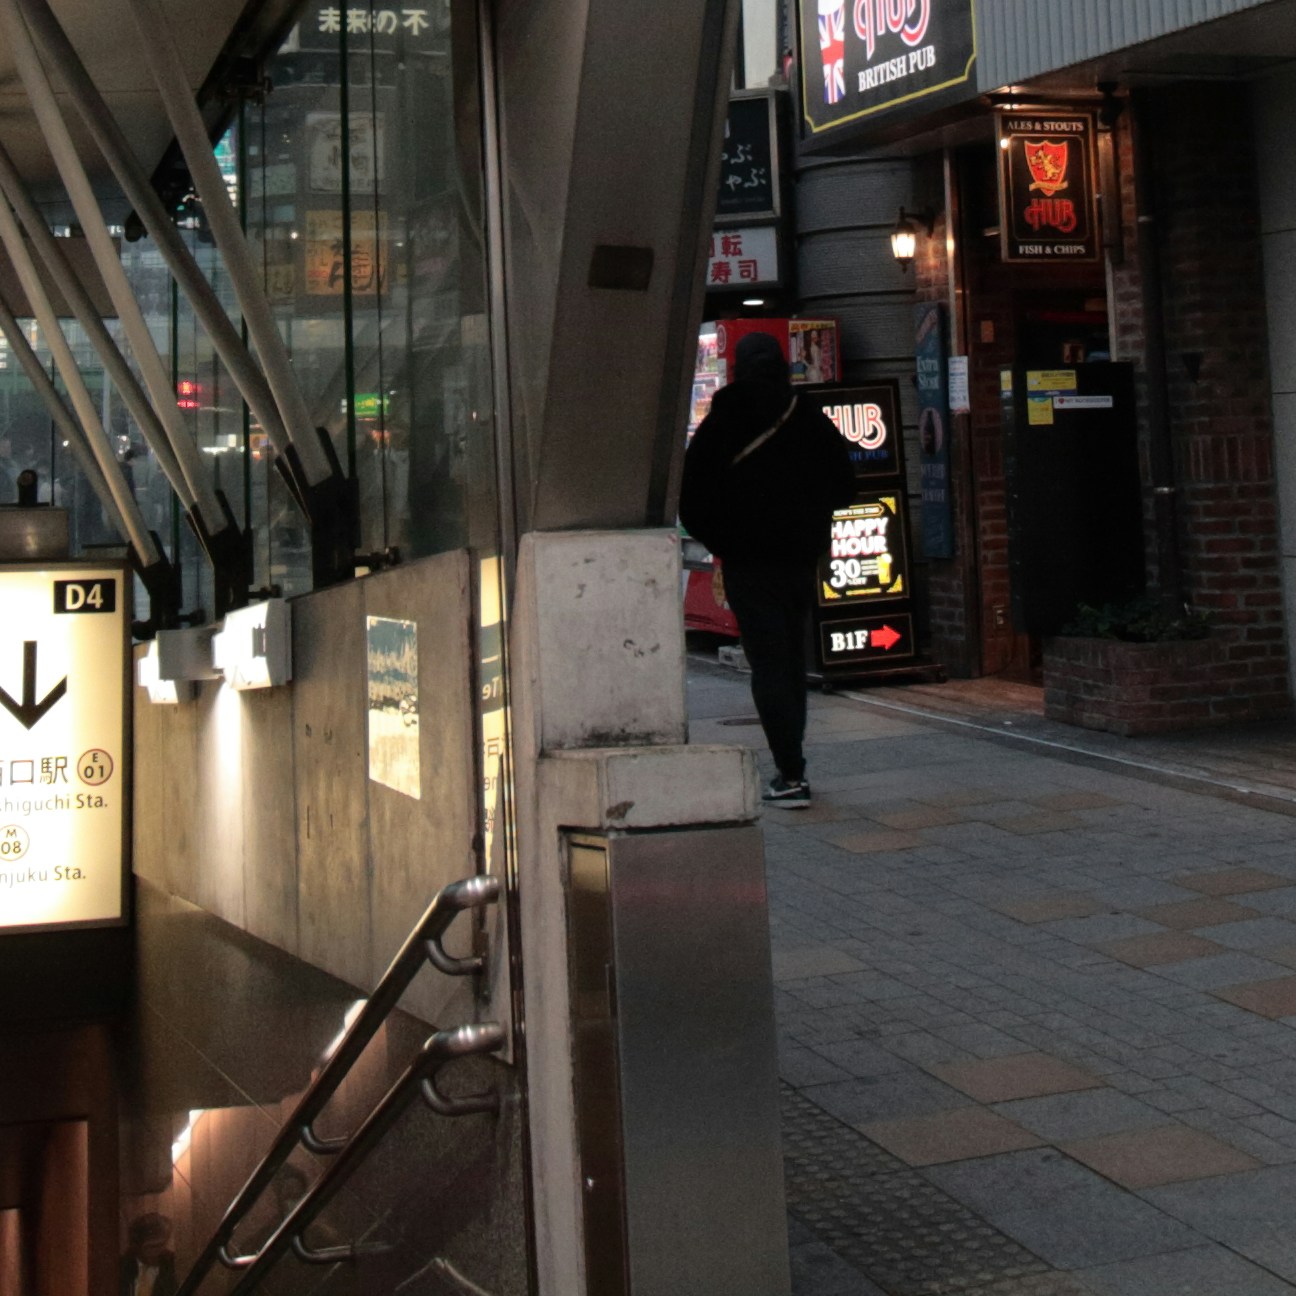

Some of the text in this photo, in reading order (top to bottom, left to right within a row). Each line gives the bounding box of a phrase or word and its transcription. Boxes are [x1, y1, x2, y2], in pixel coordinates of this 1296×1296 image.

[857, 45, 936, 92] BRITISH PUB
[1007, 120, 1084, 131] ALES & STOUTS
[1025, 198, 1077, 233] HUB
[1019, 245, 1043, 255] FISH
[1053, 245, 1085, 255] CHIPS
[710, 259, 759, 284] 寿司
[832, 517, 888, 539] HAPPY
[832, 536, 888, 558] HOUR
[830, 559, 861, 588] 30
[64, 583, 104, 610] D4
[830, 630, 869, 652] B1F
[91, 752, 99, 764] E
[83, 764, 106, 780] 01
[75, 791, 109, 810] Sta.
[5, 828, 19, 839] M
[0, 840, 23, 856] 08
[53, 863, 87, 882] Sta.
